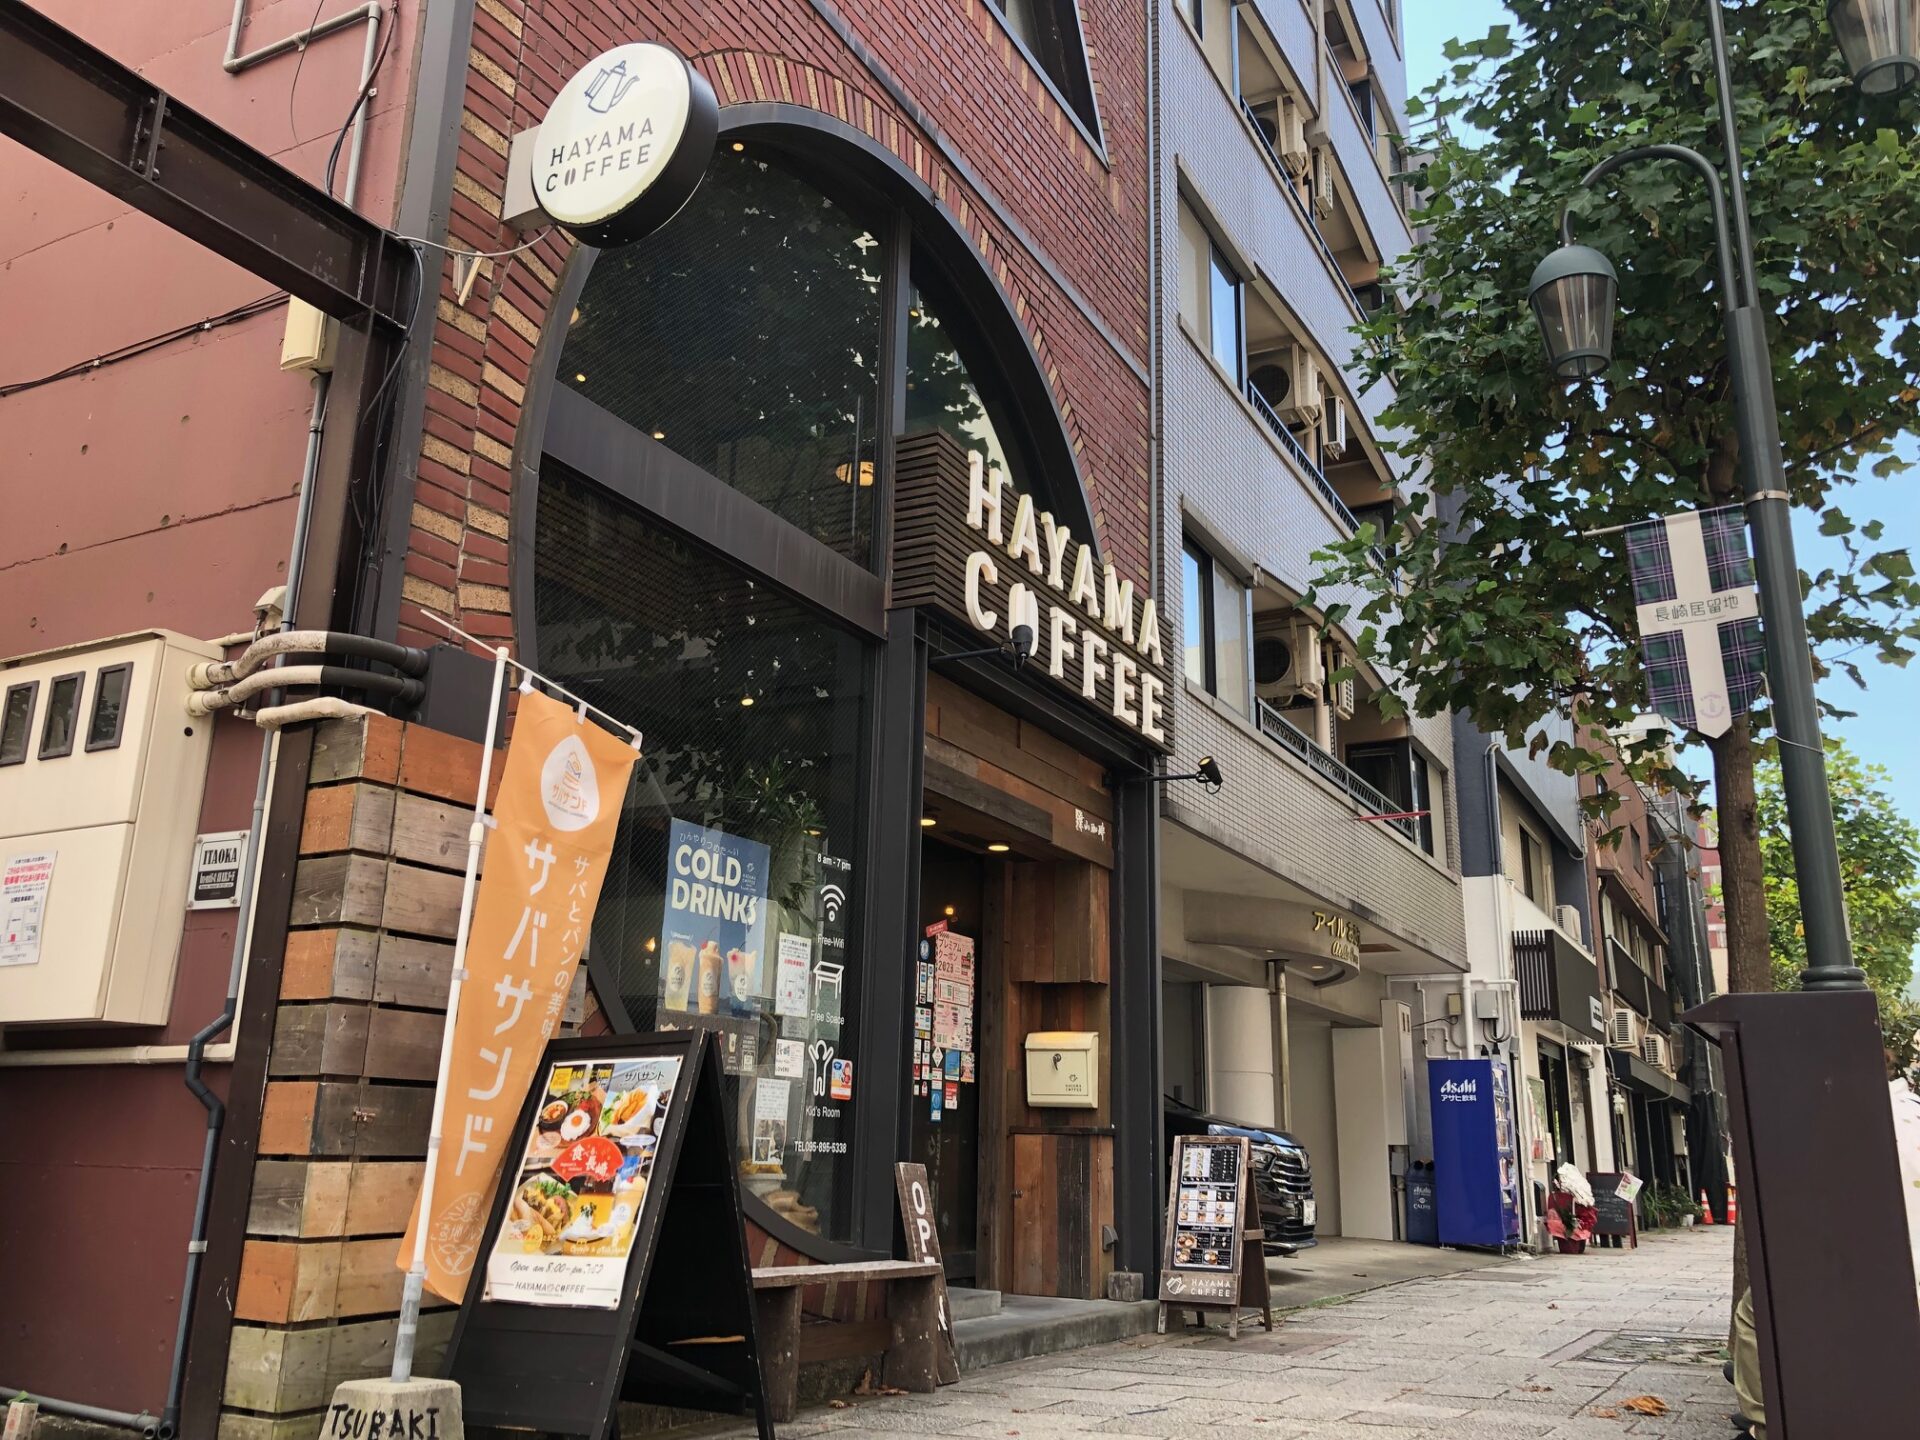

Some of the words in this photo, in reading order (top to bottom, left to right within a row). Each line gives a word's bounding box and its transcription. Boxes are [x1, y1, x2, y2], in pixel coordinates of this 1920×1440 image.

[550, 118, 654, 167] HAYAMA
[966, 449, 1164, 667] HAYAMA
[1655, 594, 1739, 622] 長崎居留地
[202, 847, 237, 865] ITAOKA
[675, 844, 742, 887] COLD
[817, 853, 822, 863] 8
[823, 857, 832, 866] am
[837, 858, 841, 868] 7
[841, 861, 852, 872] pm
[671, 878, 757, 926] DRINKS
[455, 838, 557, 1177] サバサンド
[1441, 1079, 1476, 1093] Asahi
[1441, 1094, 1477, 1102] アサヒ飲料
[822, 1106, 840, 1118] Room
[1191, 1278, 1232, 1289] HAYAMA
